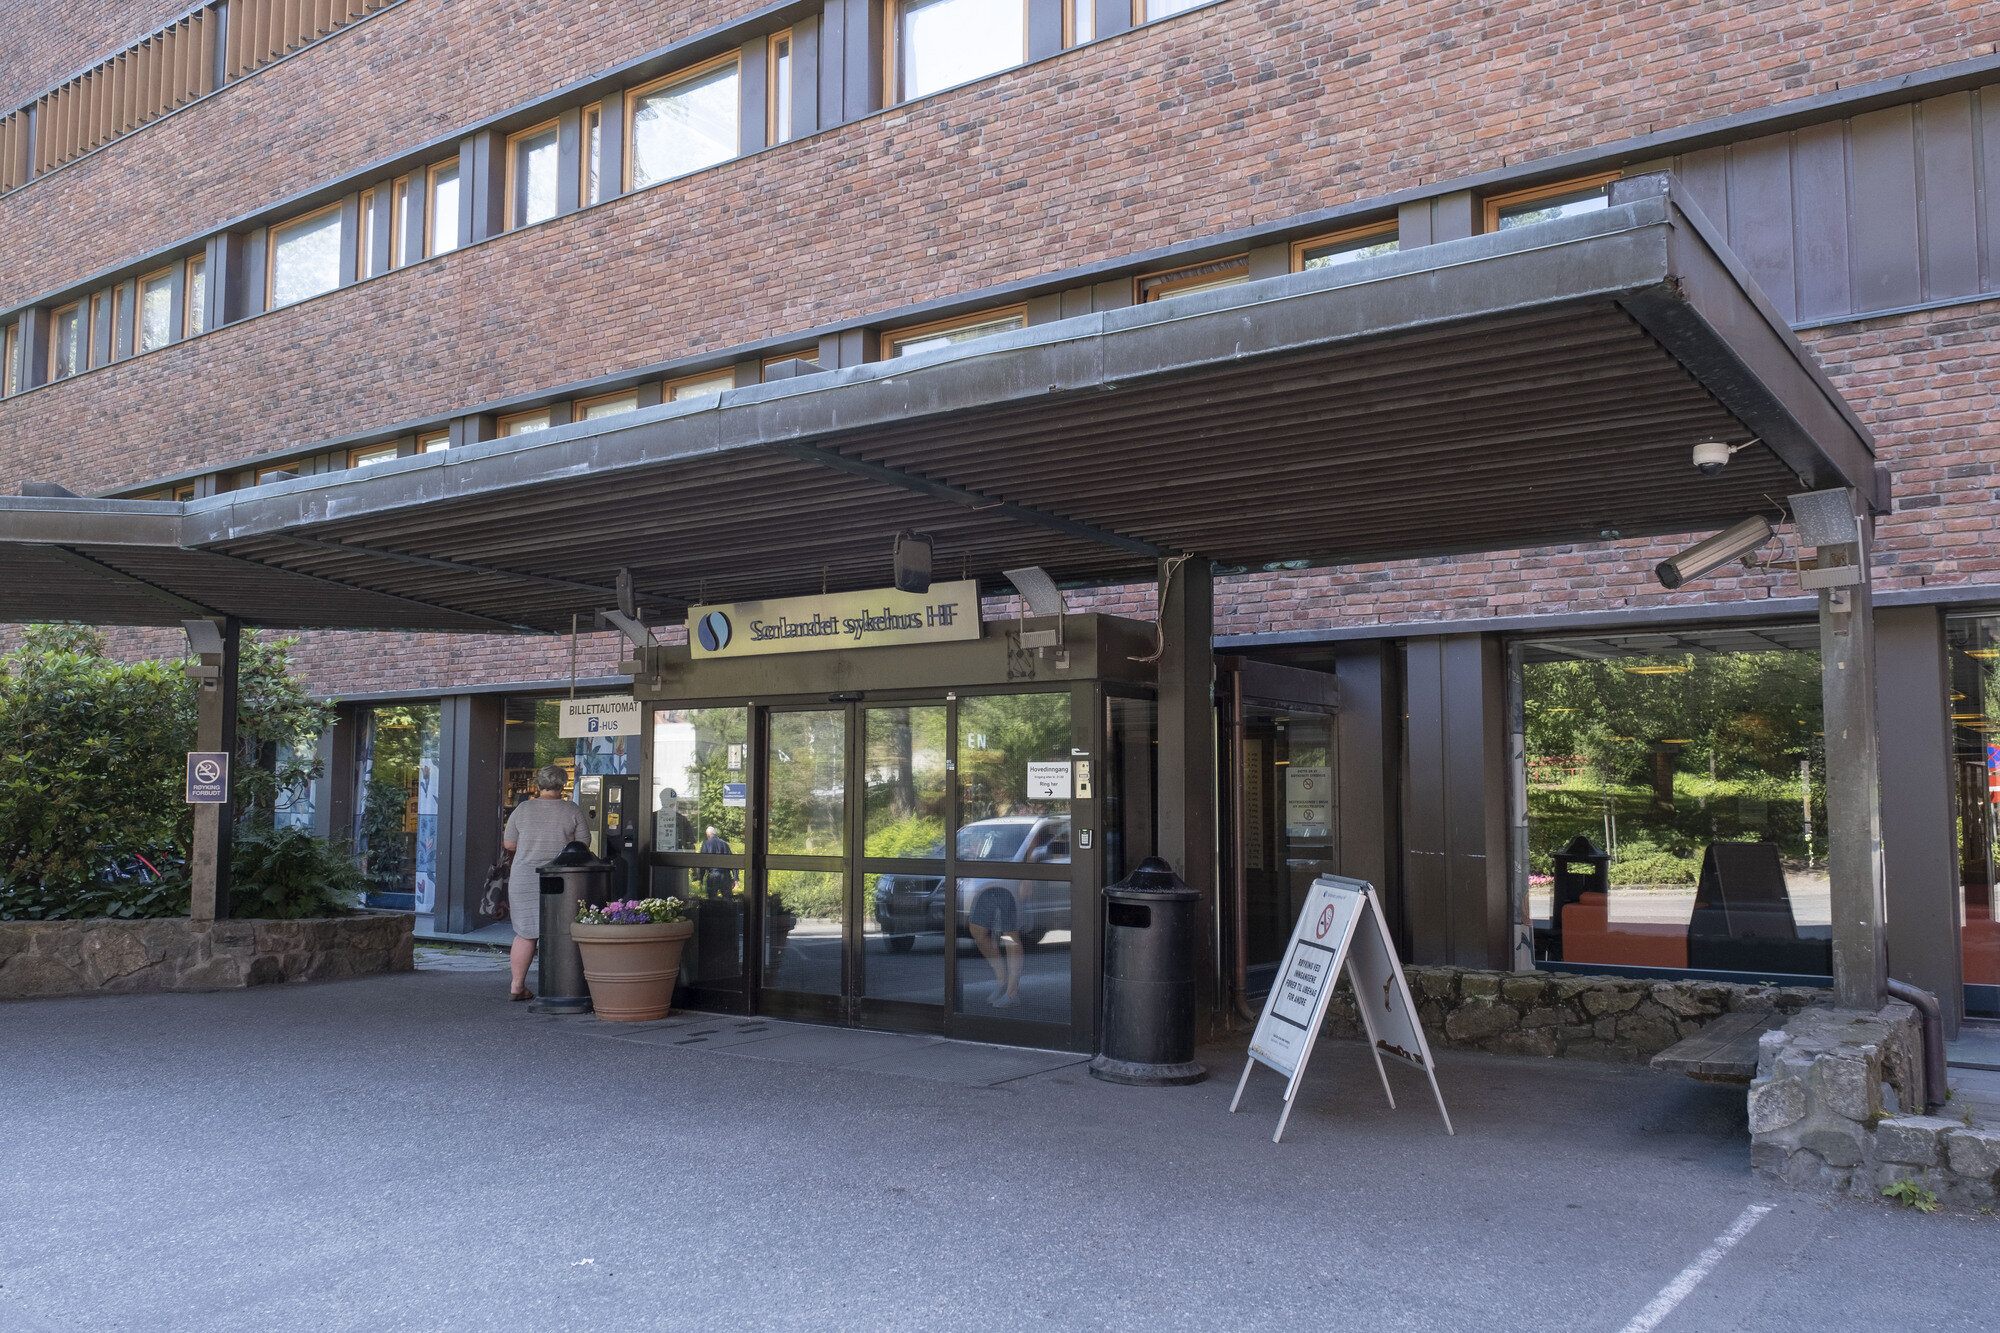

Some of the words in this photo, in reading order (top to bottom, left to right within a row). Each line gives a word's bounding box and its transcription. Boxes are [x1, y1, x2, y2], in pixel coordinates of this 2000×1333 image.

[842, 606, 923, 640] sykehus
[925, 602, 958, 627] HF
[569, 701, 639, 715] BILLETTAUTOMAT
